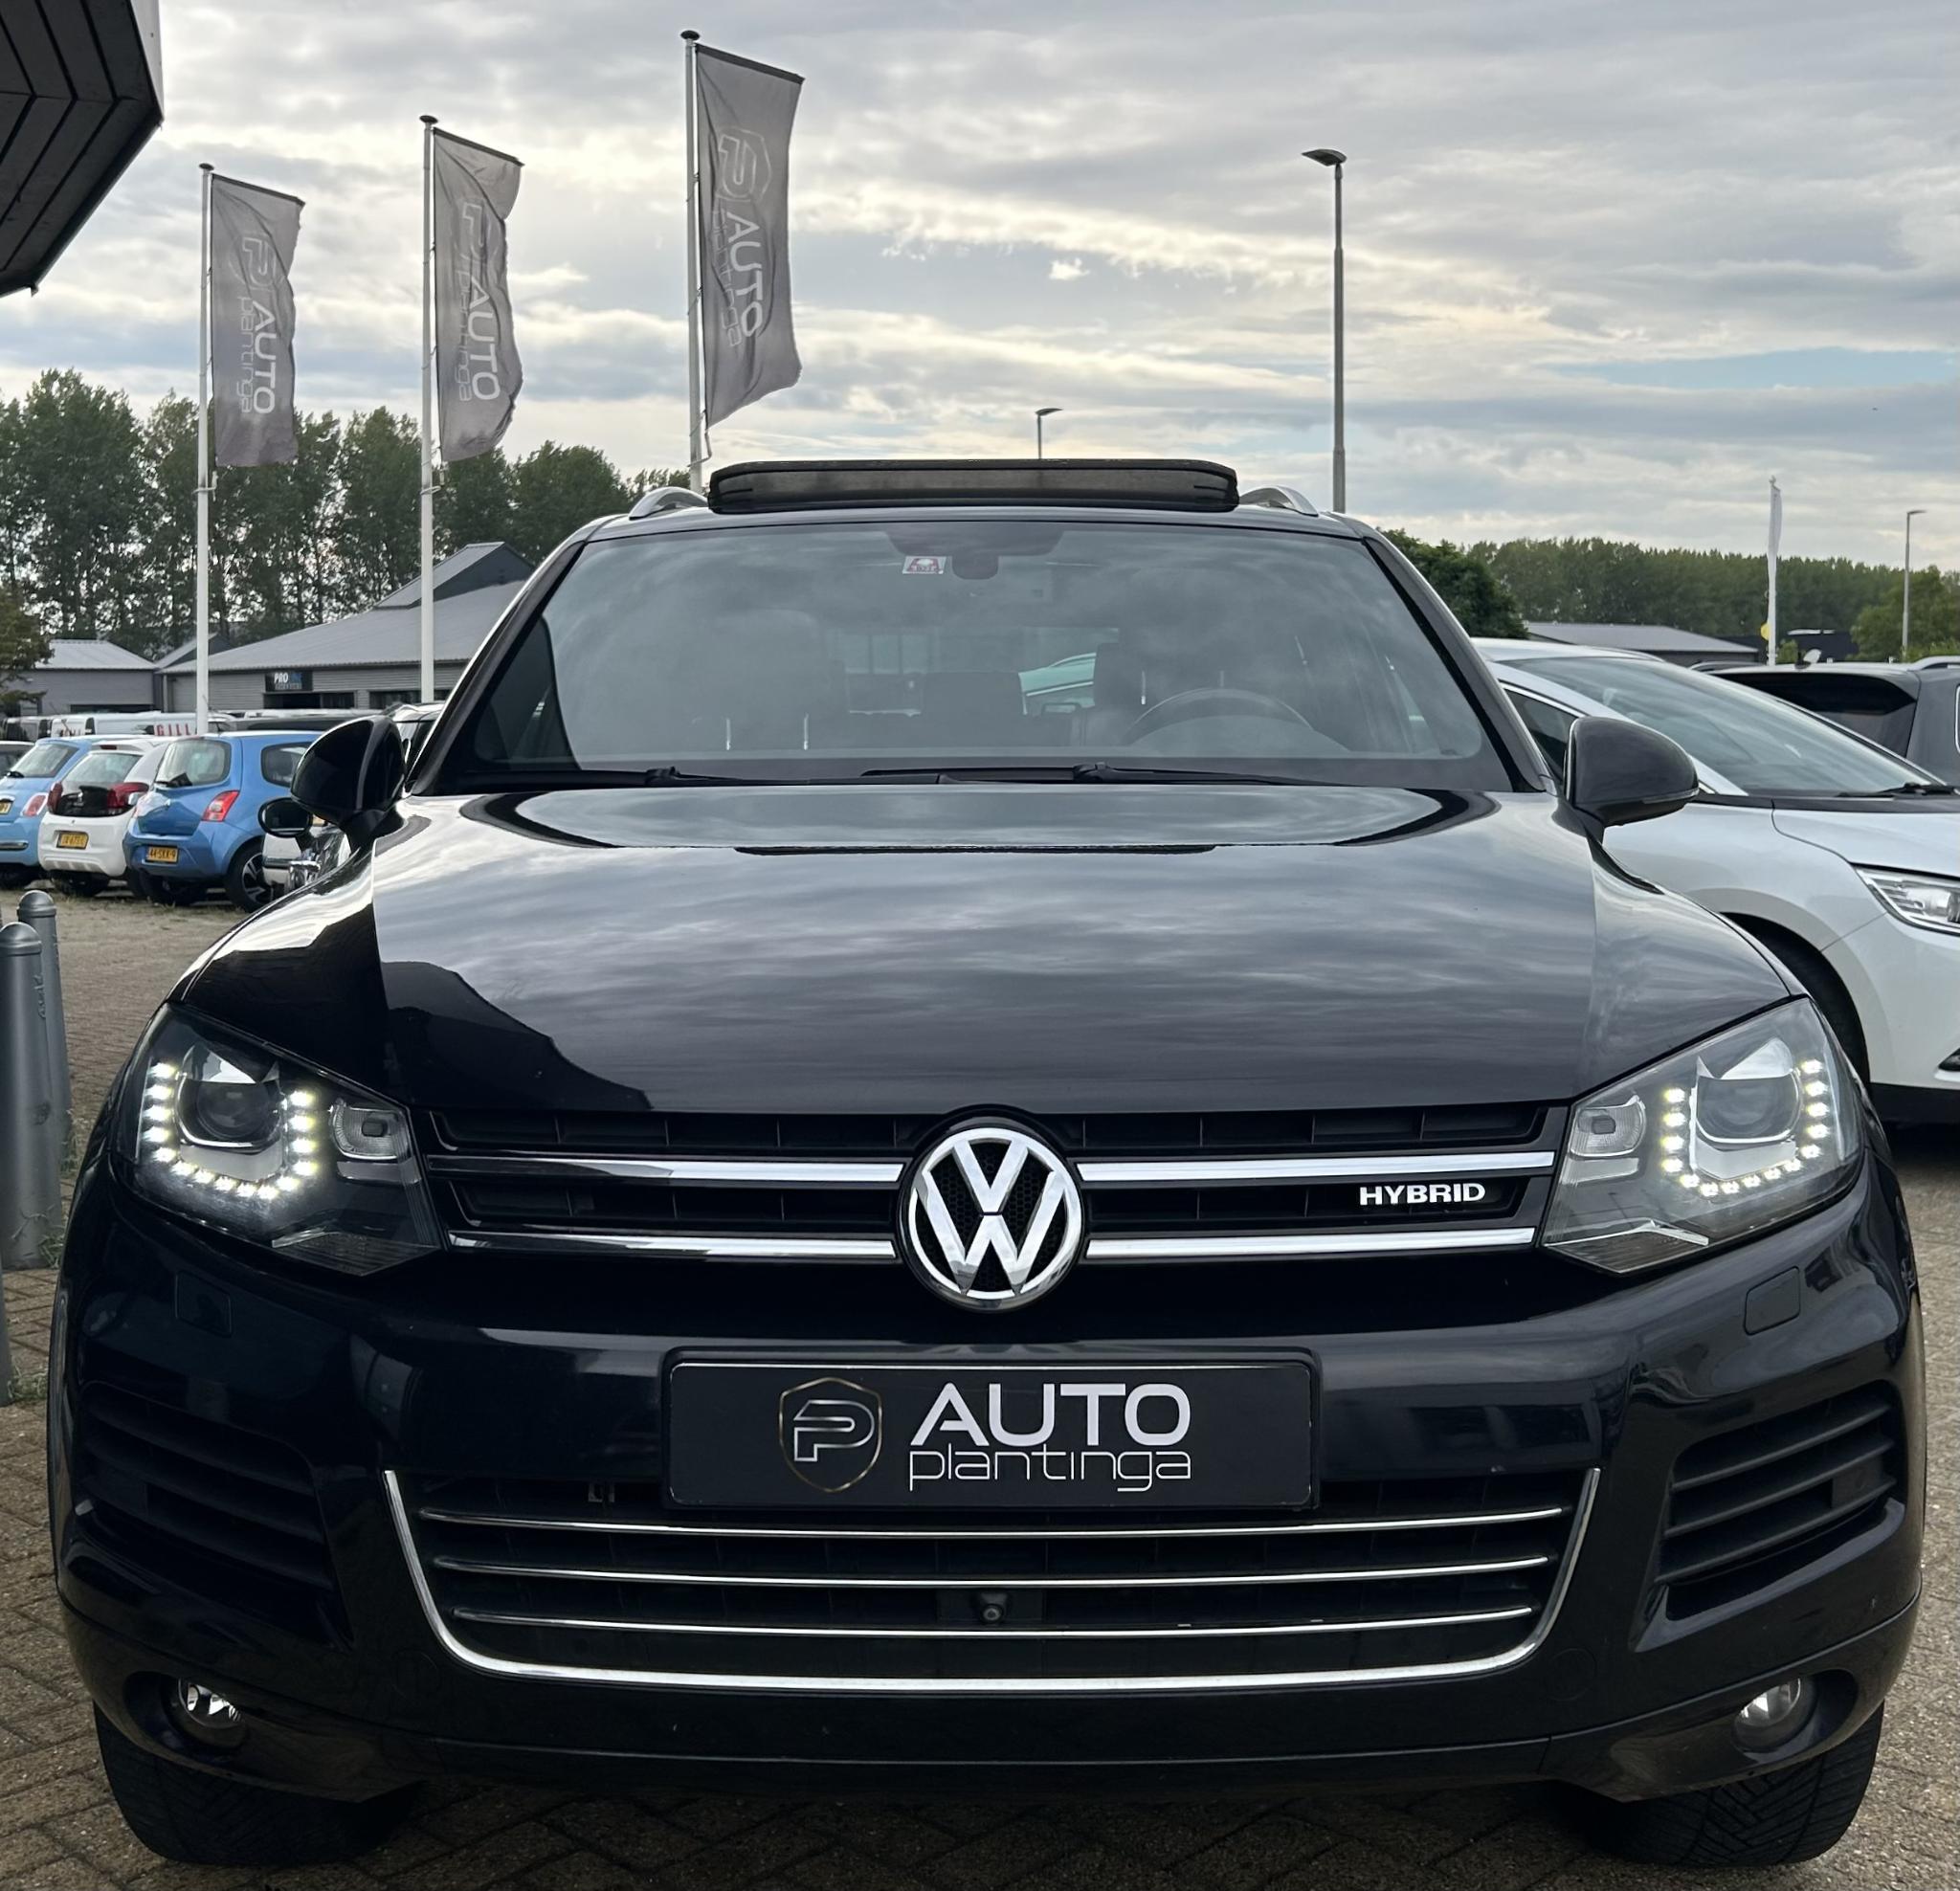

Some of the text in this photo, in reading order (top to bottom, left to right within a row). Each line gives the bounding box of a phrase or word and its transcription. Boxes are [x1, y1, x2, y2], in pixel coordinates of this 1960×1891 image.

[726, 211, 763, 337] AUTO
[252, 300, 277, 414] AUTO
[468, 275, 501, 400] AUTO
[1359, 1183, 1486, 1206] HYBRID
[910, 1383, 1192, 1447] AUTO
[909, 1443, 1192, 1492] plantinga
